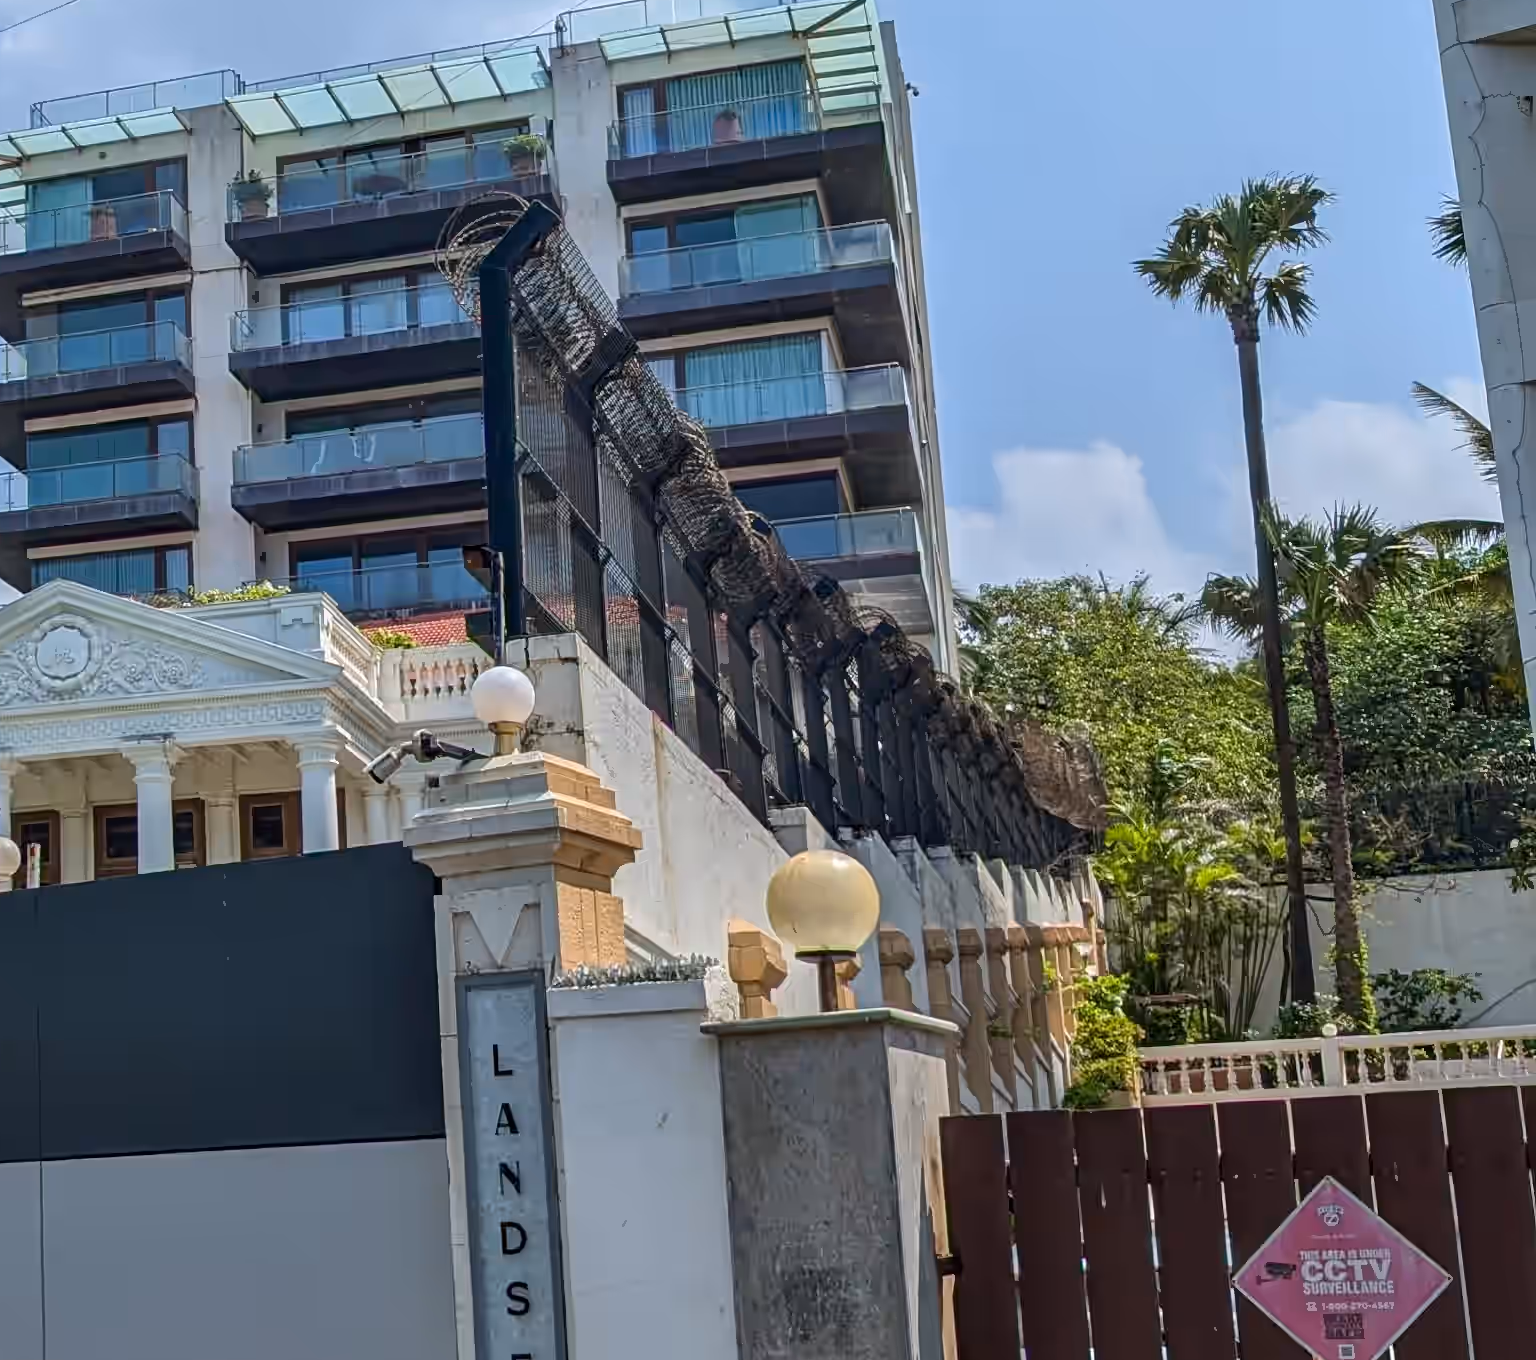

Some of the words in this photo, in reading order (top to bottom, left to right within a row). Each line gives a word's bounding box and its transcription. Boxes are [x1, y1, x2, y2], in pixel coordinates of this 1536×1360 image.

[1322, 1249, 1345, 1260] AREA
[1359, 1248, 1391, 1259] UNDER
[1301, 1258, 1392, 1282] CCTV
[1303, 1280, 1395, 1295] SURVEILLANCE
